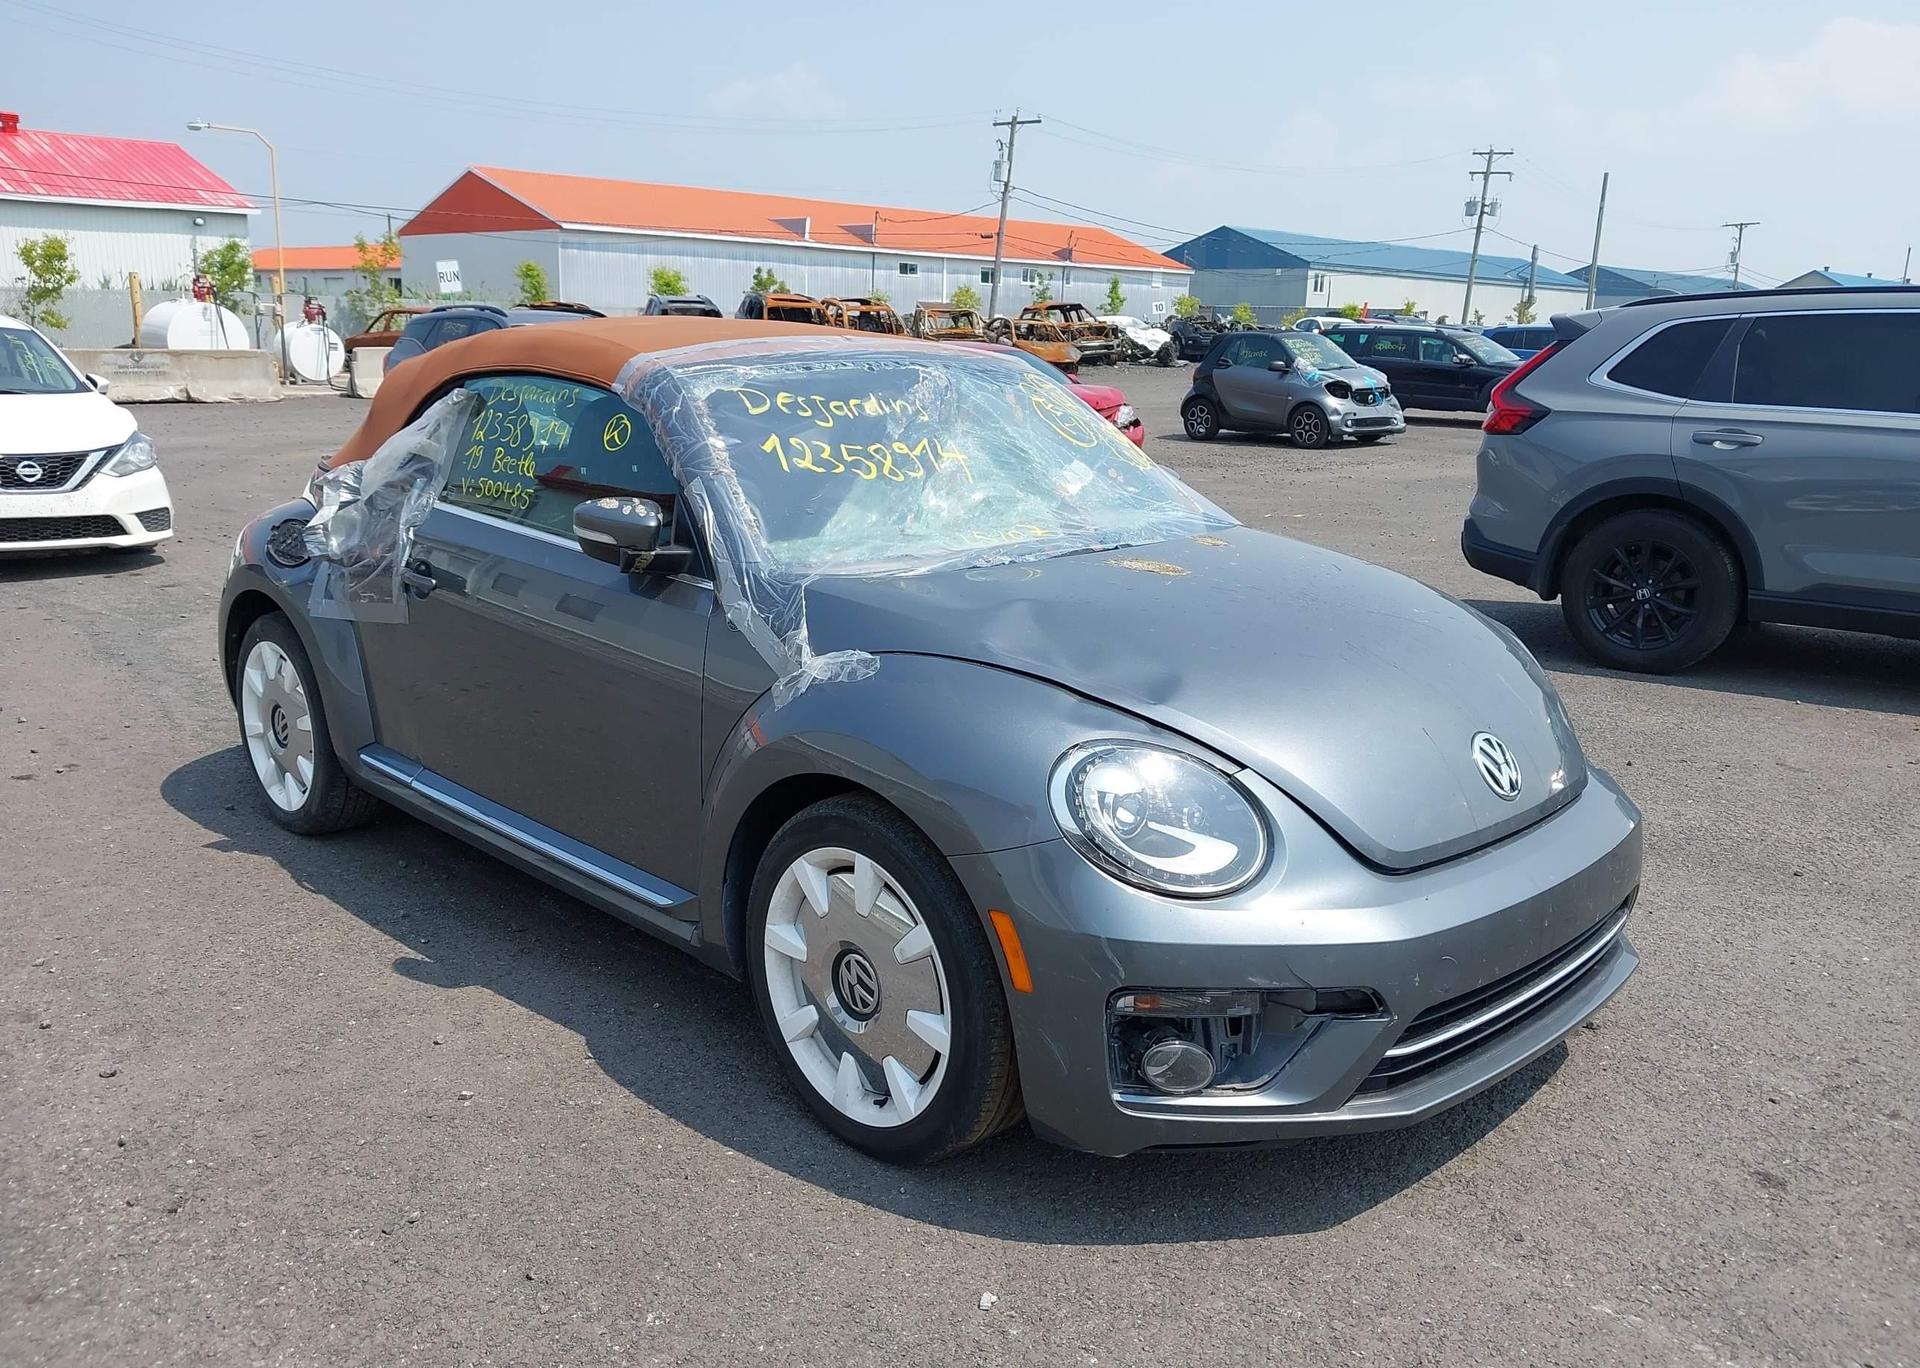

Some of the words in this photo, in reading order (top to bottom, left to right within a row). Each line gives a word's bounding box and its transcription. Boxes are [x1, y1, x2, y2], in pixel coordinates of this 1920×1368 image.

[438, 271, 460, 283] RUN
[1155, 303, 1164, 312] 10
[473, 409, 569, 453] 12358914
[465, 445, 484, 470] 19
[492, 447, 536, 479] Beetle
[760, 433, 974, 483] 12358914
